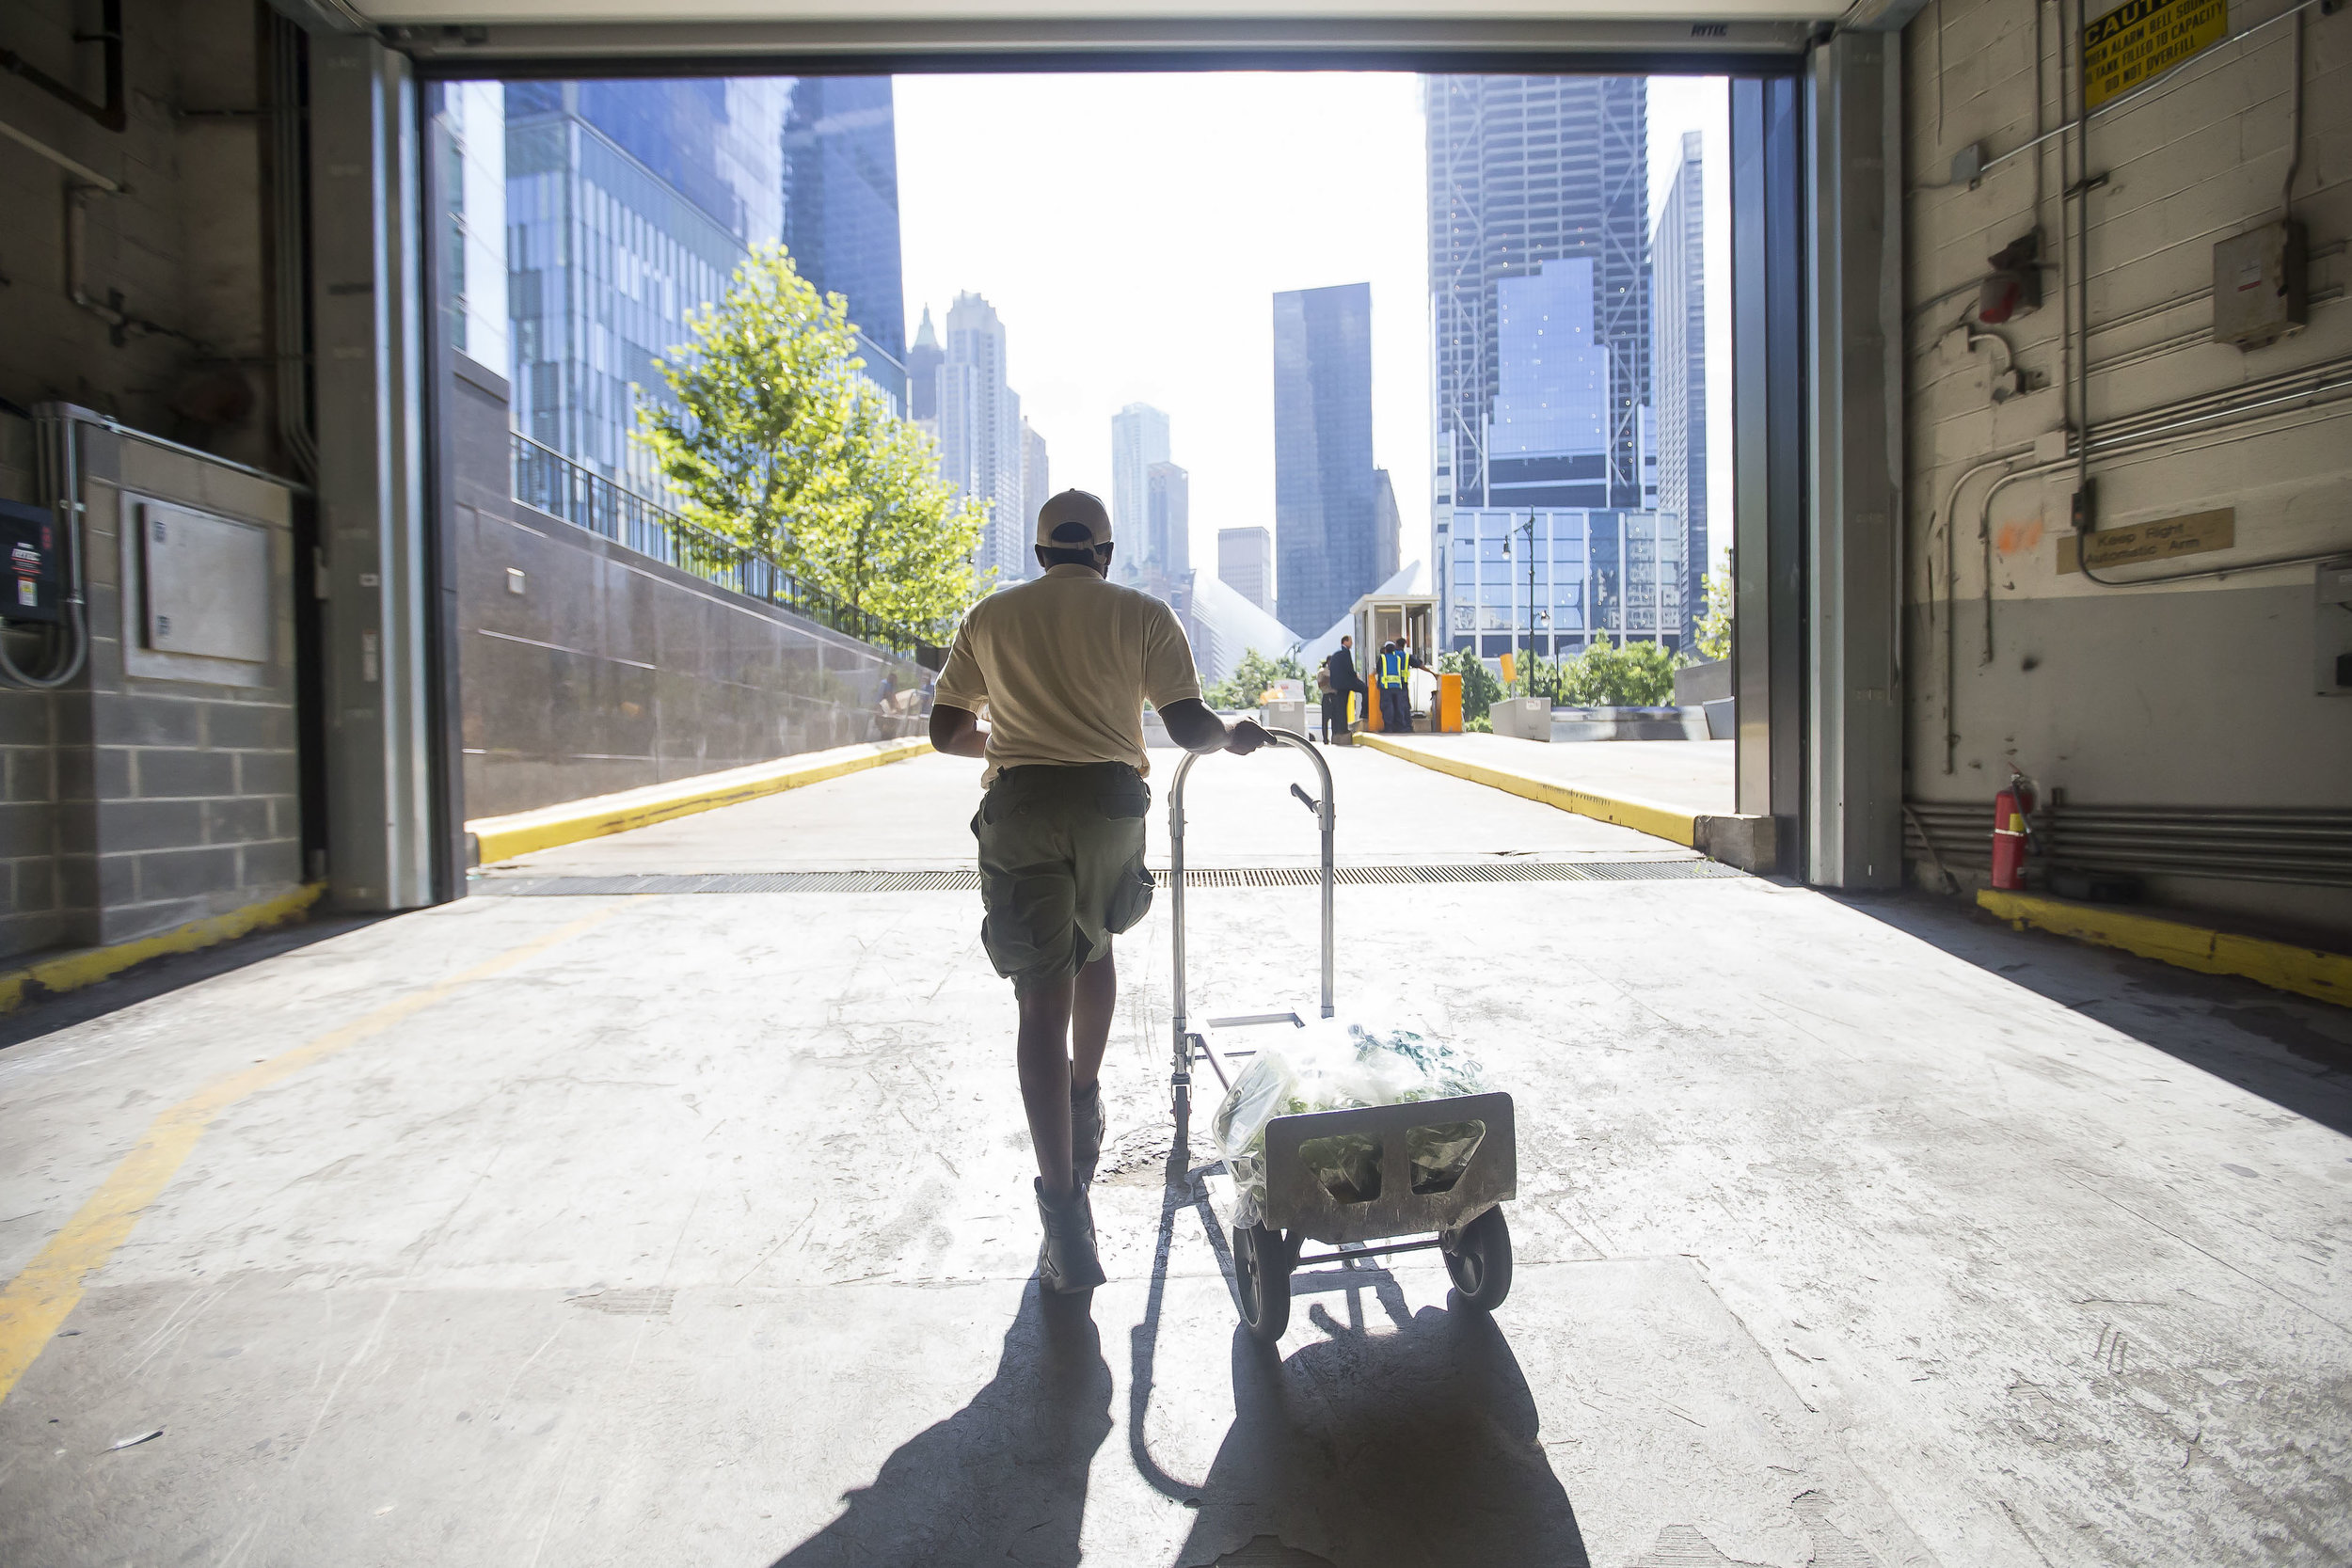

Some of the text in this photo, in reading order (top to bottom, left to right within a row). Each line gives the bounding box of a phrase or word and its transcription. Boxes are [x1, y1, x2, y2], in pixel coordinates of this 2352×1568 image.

[2085, 0, 2167, 46] CAUT
[2096, 58, 2119, 79] TANK
[2122, 39, 2153, 64] FILLED
[2157, 31, 2168, 47] TO
[2171, 2, 2223, 40] CAPACITY
[2111, 25, 2144, 54] ALARM
[2149, 10, 2171, 33] BELL
[2106, 35, 2195, 93] DO NOT OVERFILL
[2086, 538, 2201, 563] Automatic Arm
[2097, 523, 2185, 547] Keep Right
